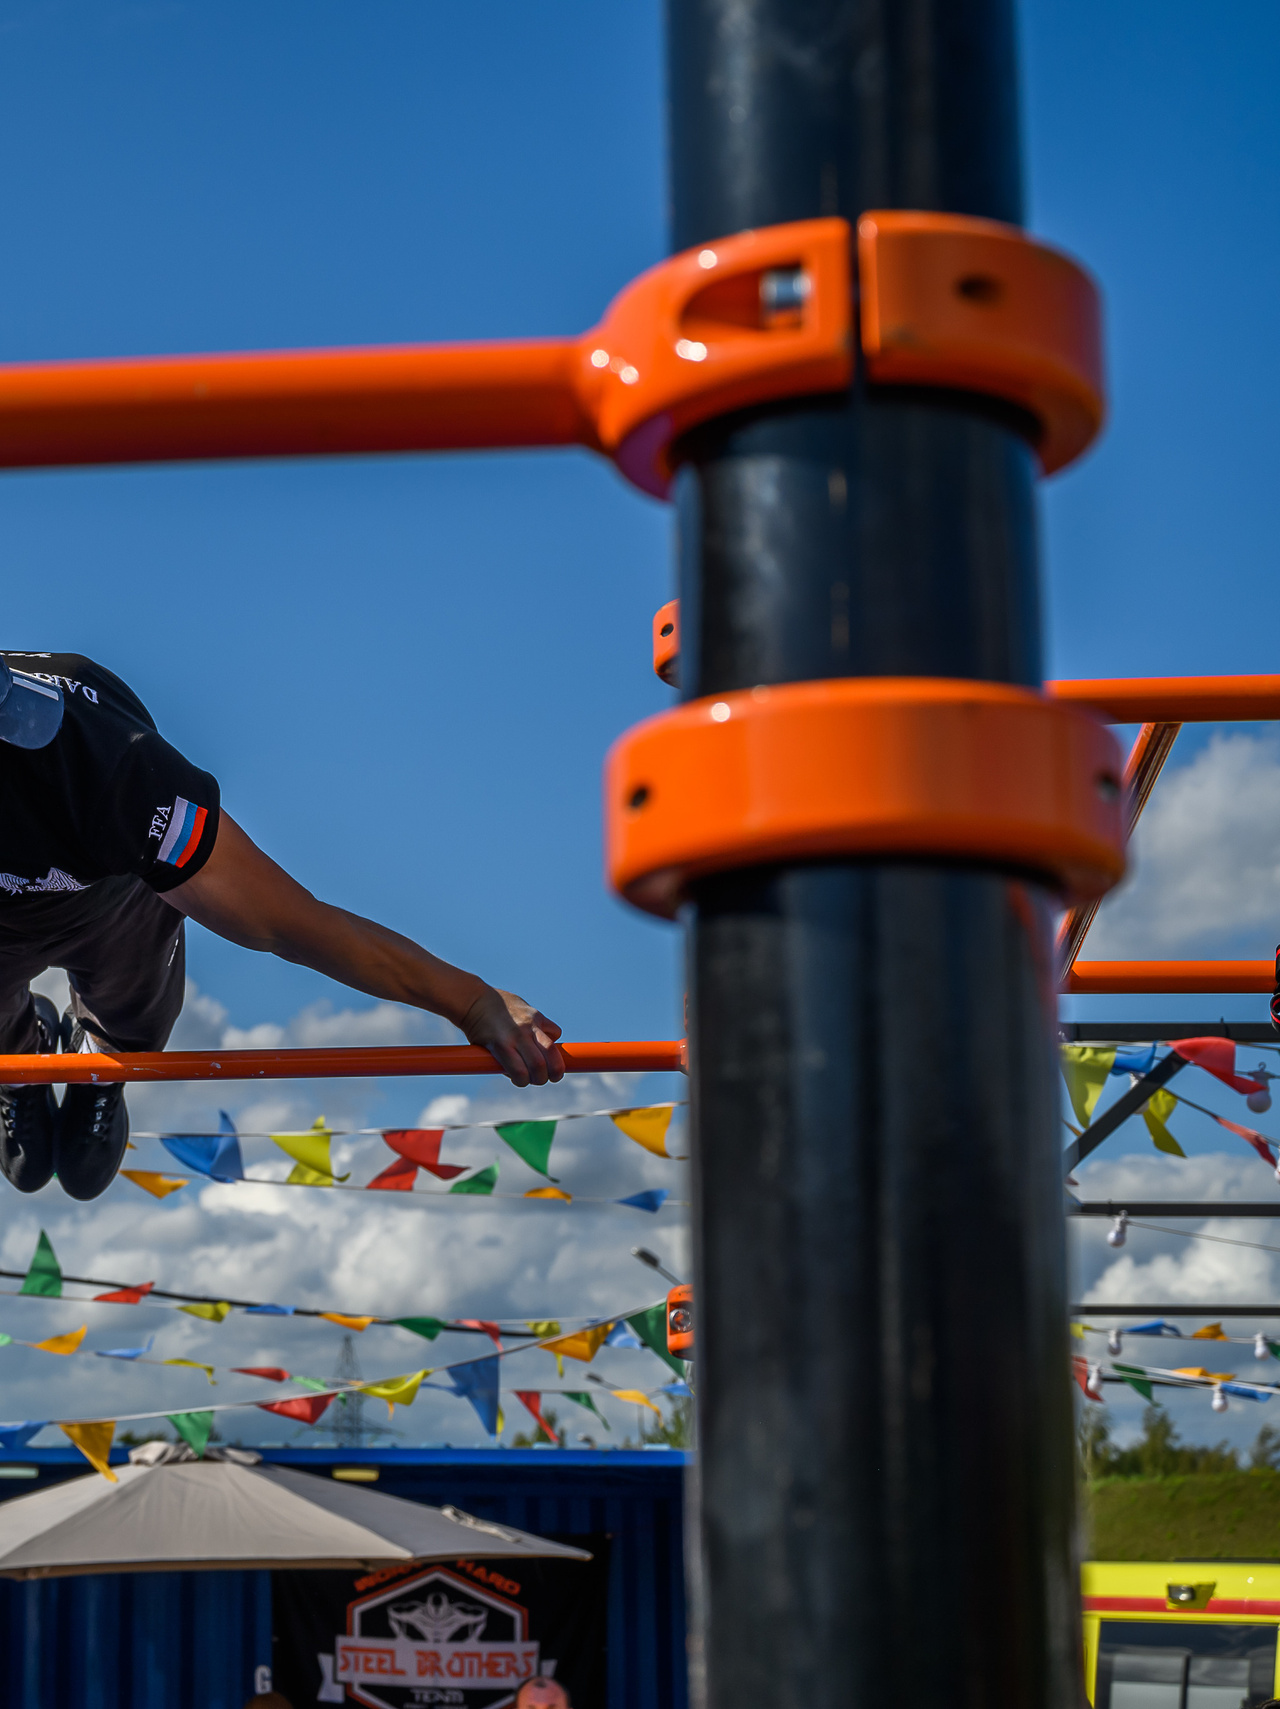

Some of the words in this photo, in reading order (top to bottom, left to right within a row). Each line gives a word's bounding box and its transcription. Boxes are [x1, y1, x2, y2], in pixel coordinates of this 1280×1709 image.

[148, 805, 172, 842] FFA
[339, 1645, 406, 1676] STEEL
[416, 1650, 536, 1679] BROTHERS
